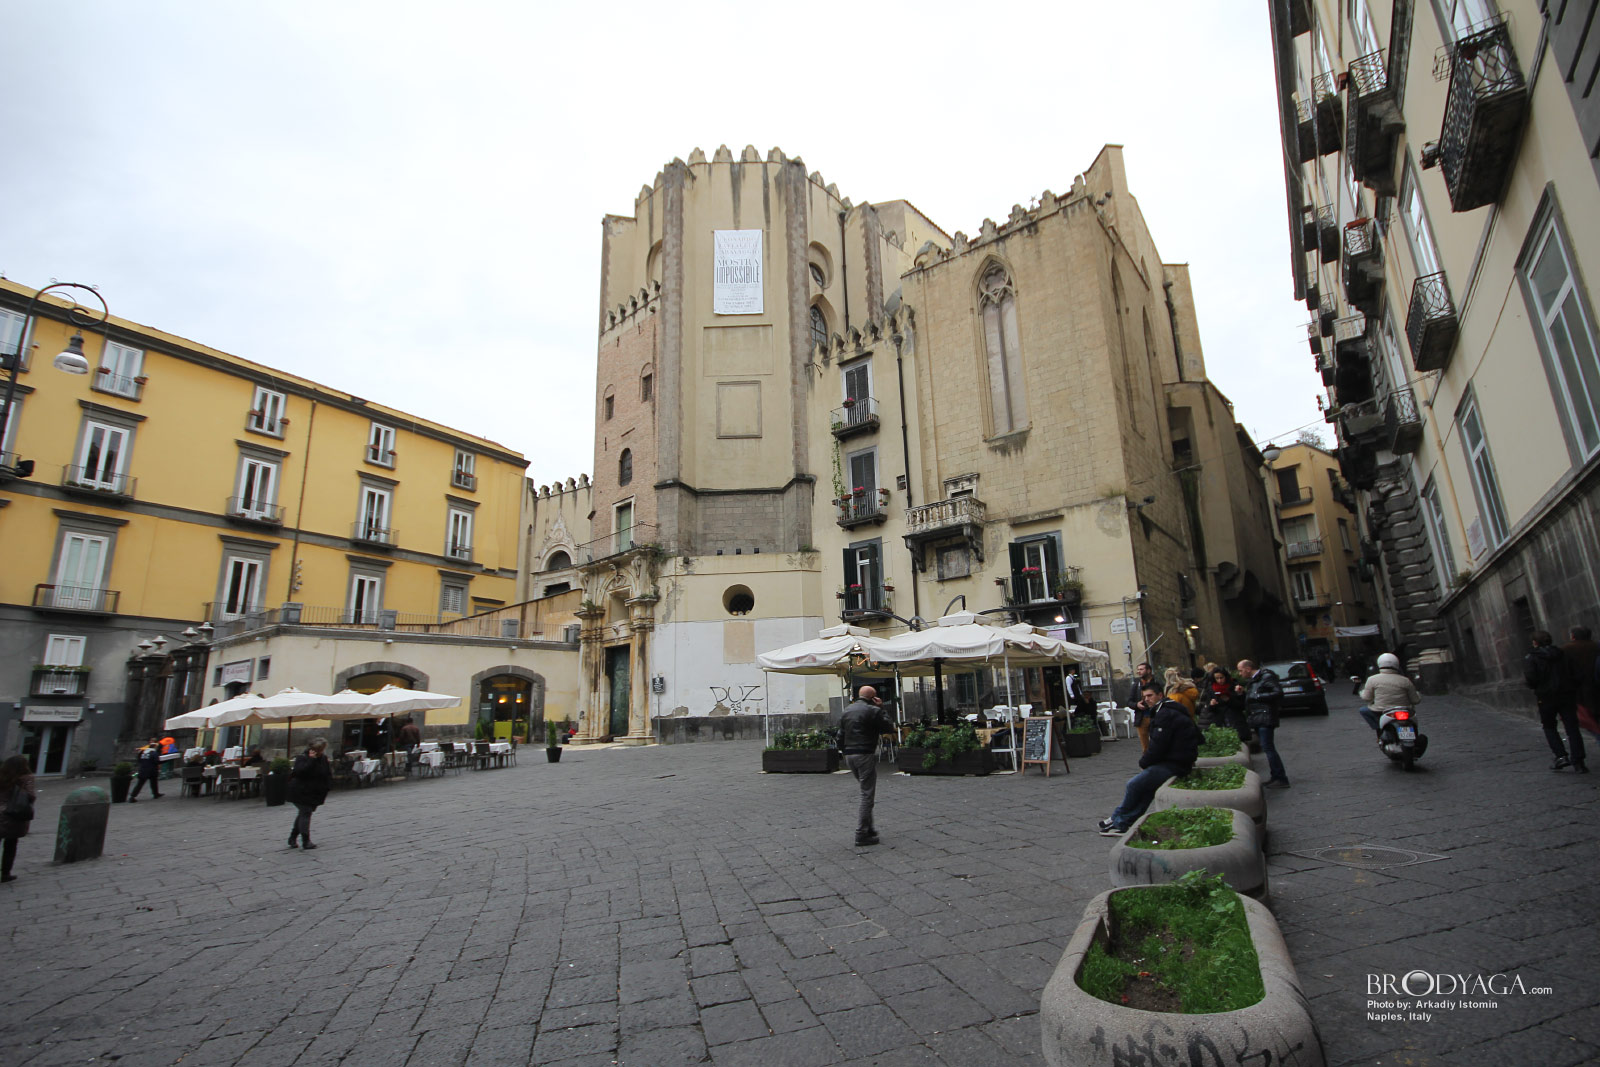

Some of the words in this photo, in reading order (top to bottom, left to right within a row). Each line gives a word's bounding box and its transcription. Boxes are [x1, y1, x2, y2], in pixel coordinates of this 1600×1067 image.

[717, 258, 760, 266] MOSTRA
[716, 265, 760, 284] IMPOSSIBILE
[710, 685, 765, 702] DUZ
